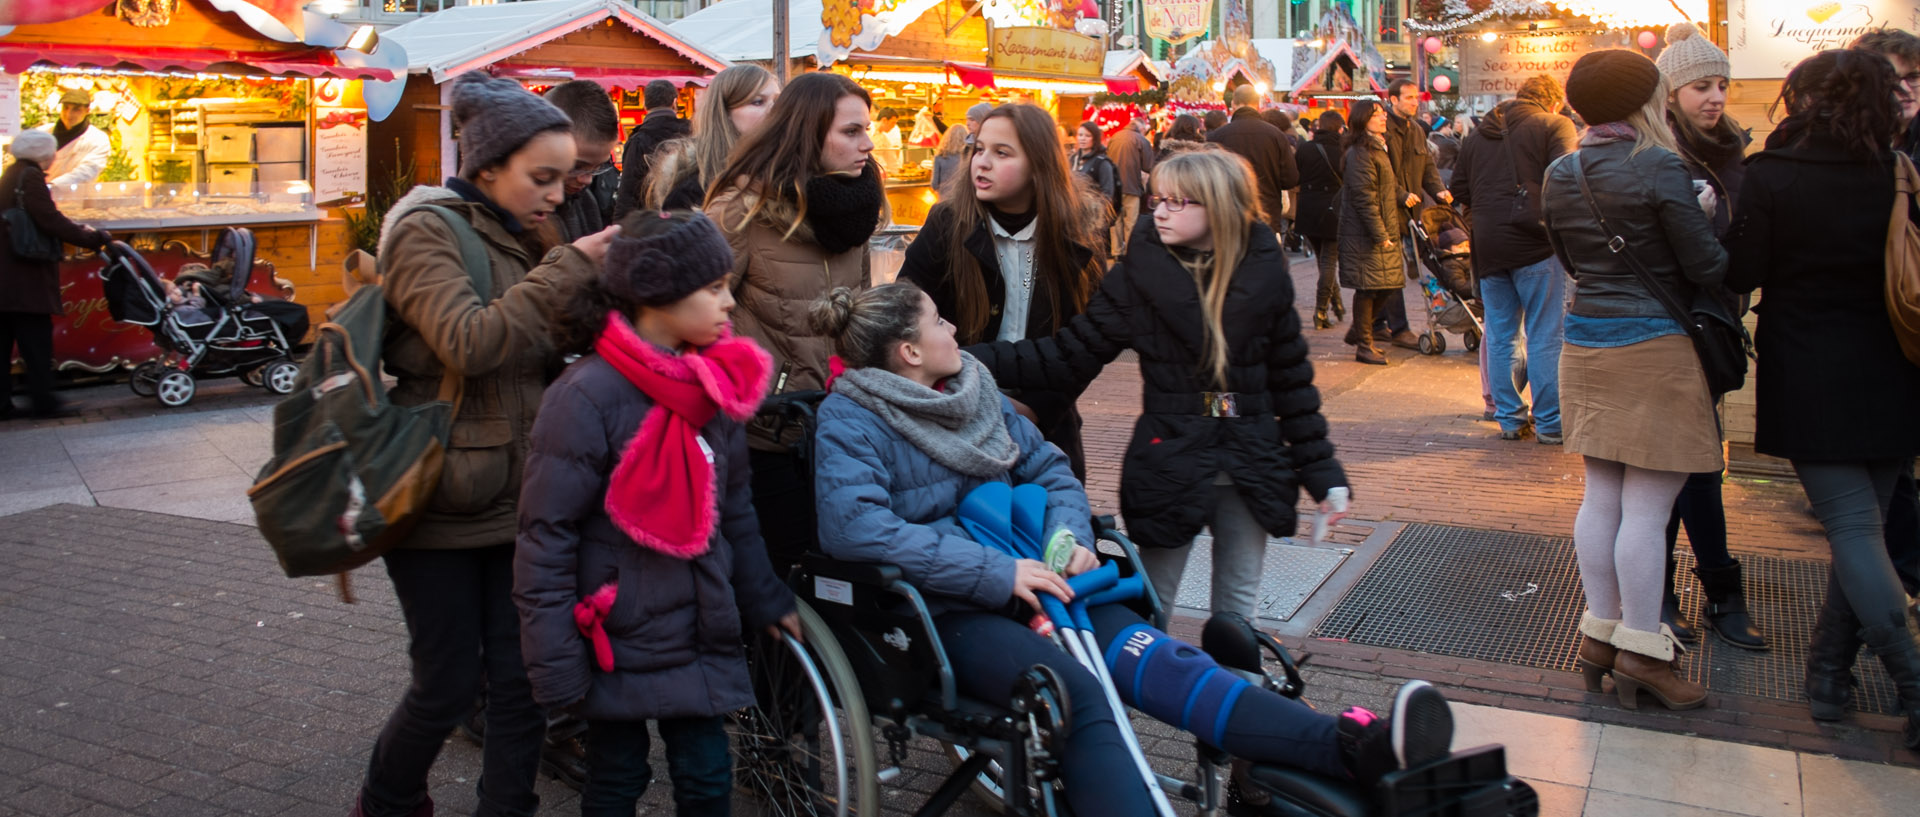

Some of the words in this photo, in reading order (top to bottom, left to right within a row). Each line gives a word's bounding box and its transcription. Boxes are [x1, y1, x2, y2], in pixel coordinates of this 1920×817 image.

[1163, 5, 1200, 28] Noël
[1769, 19, 1888, 43] Lacquema
[997, 31, 1067, 64] Lacquemant
[1068, 47, 1078, 60] de
[1811, 38, 1828, 51] de
[1482, 60, 1511, 72] See
[1514, 61, 1549, 72] you
[1553, 60, 1570, 71] so
[1479, 79, 1502, 91] Tot
